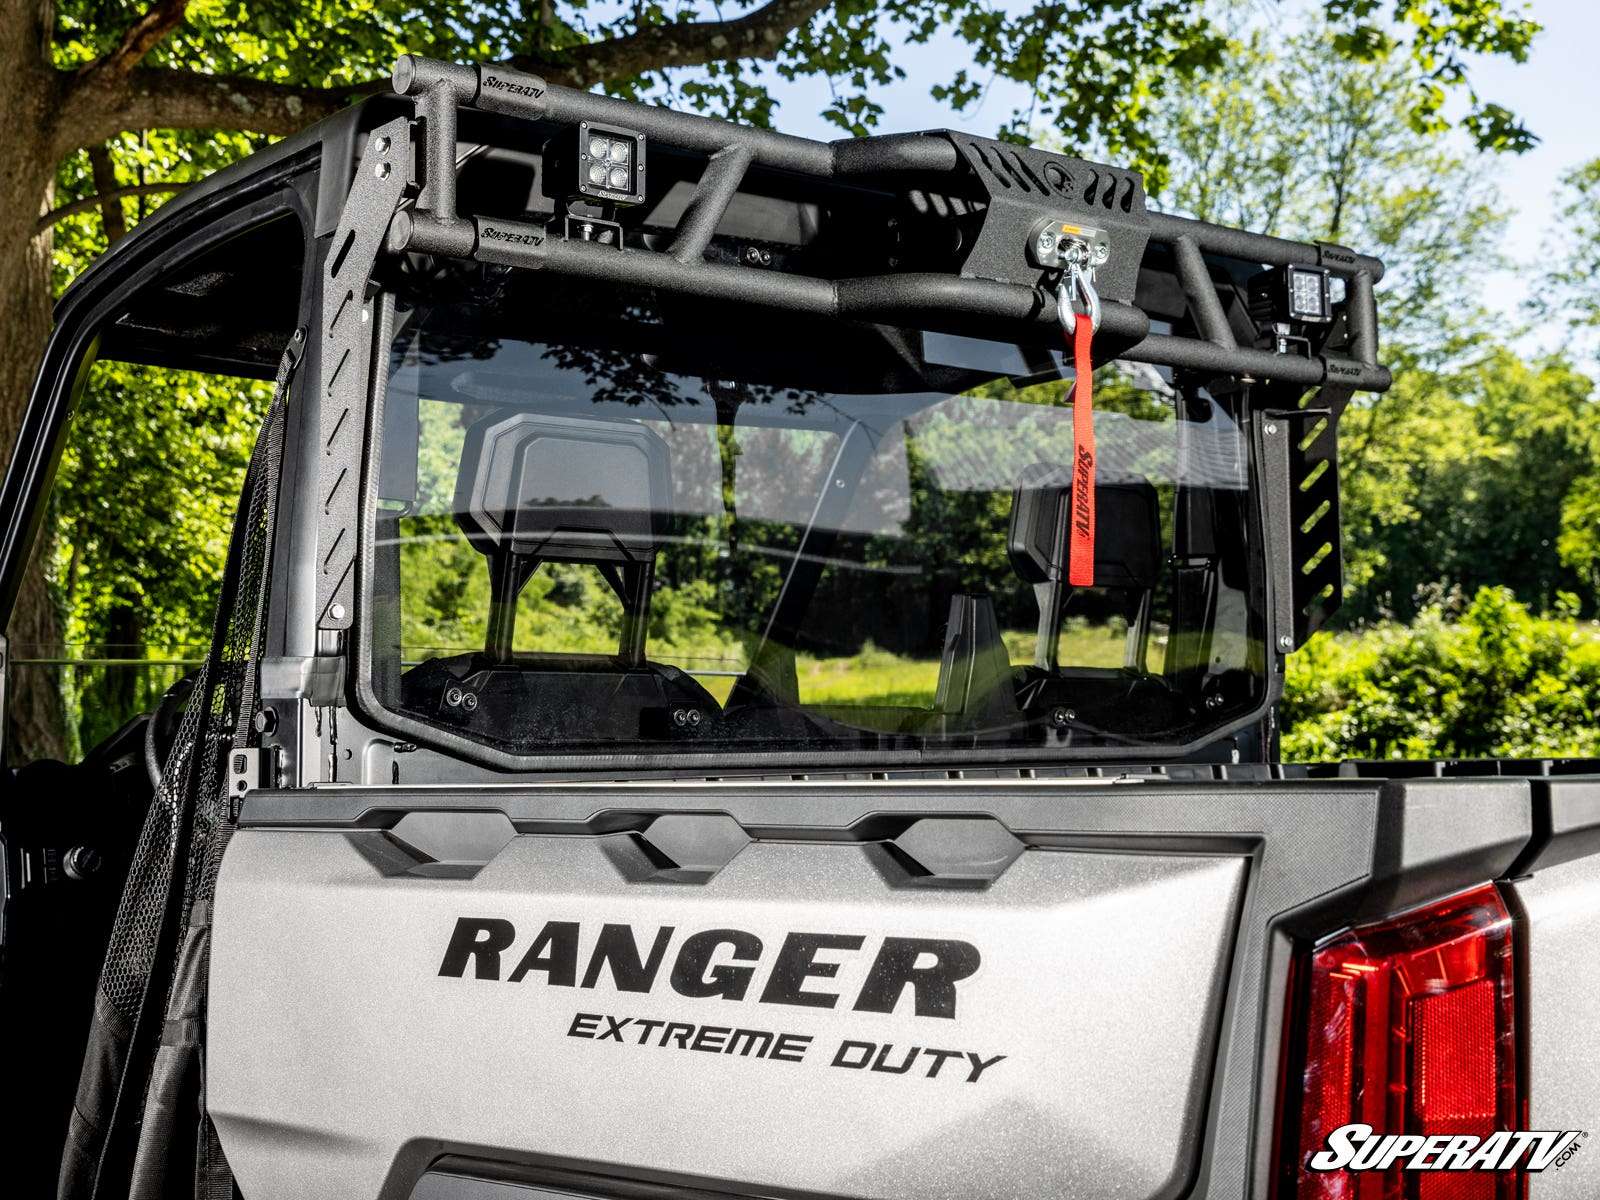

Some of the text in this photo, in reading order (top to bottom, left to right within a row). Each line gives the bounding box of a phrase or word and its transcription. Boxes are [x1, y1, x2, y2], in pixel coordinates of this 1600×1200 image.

[438, 917, 981, 1019] RANGER
[566, 1012, 1007, 1083] EXTREME DUTY
